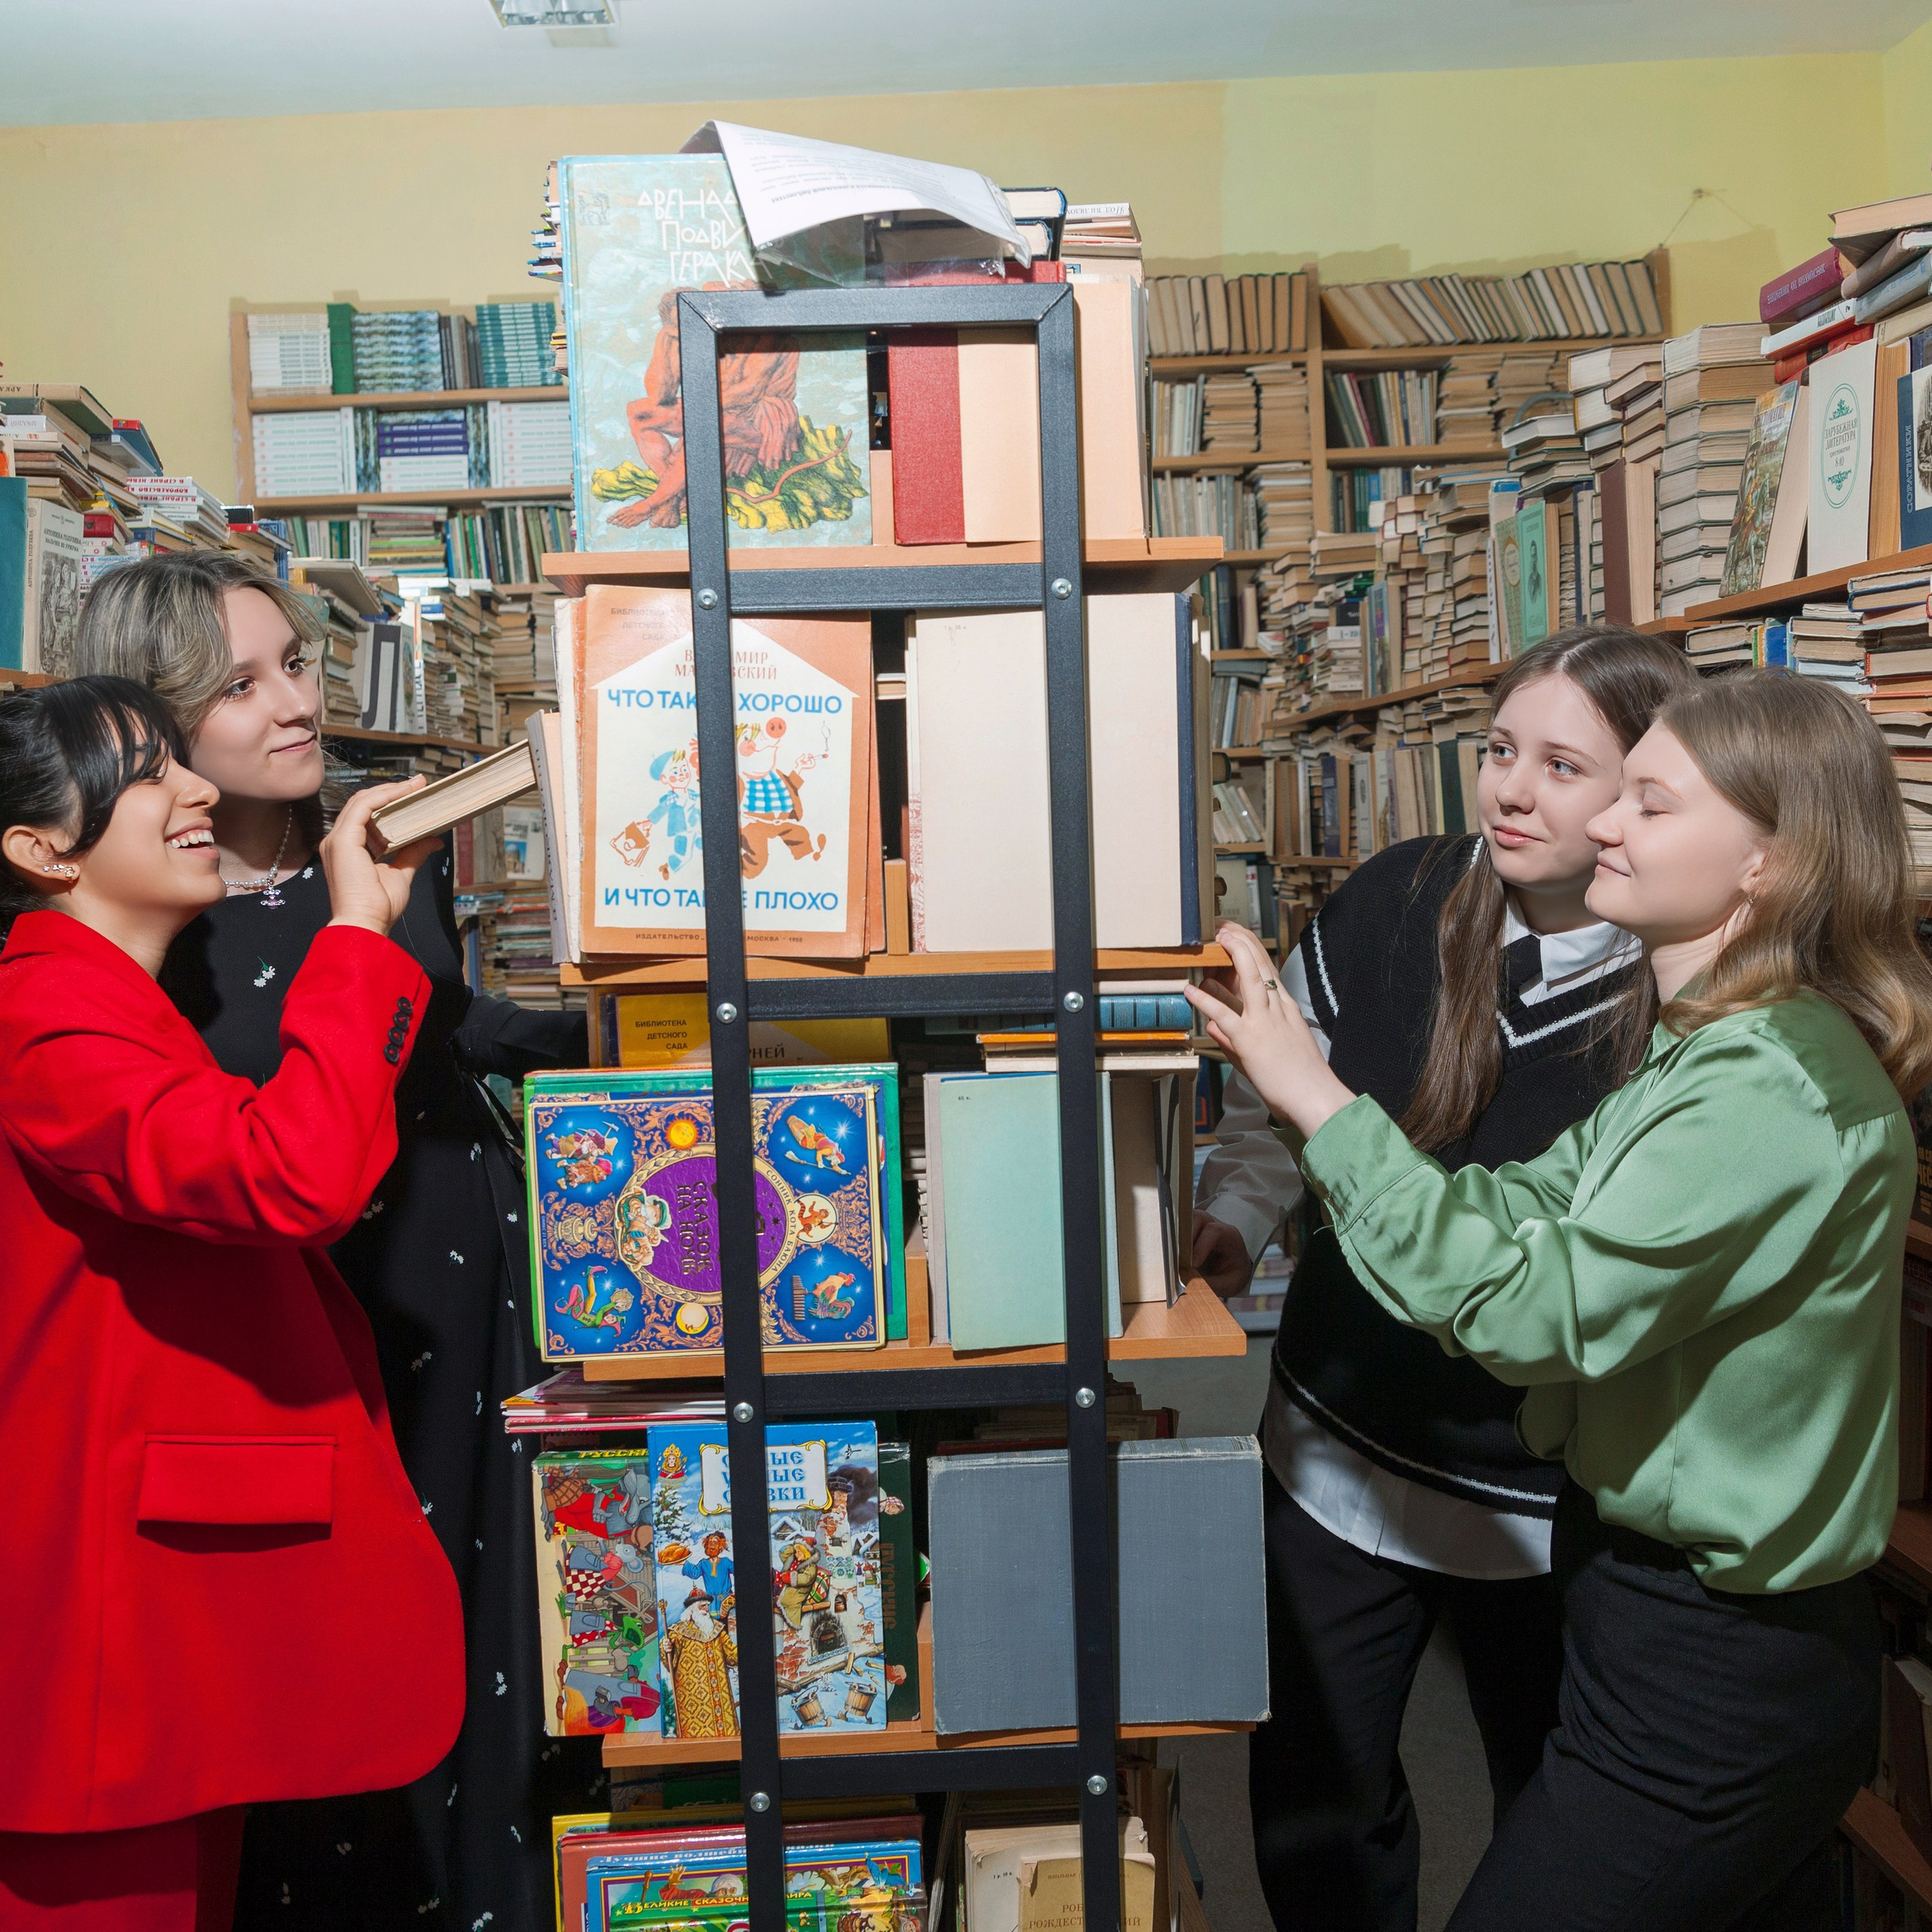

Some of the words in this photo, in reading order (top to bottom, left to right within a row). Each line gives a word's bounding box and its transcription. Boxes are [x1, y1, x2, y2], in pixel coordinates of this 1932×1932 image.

[1824, 417, 1857, 439] ЗАРУБЕЖНАЯ
[1825, 429, 1856, 451] ЛИТЕРАТУРА
[611, 608, 666, 617] БИБЛИОТЕКА
[621, 621, 665, 629] ДЕТСКОГО
[641, 632, 665, 641] САДА
[608, 688, 654, 709] ЧТО
[657, 691, 699, 709] ТАК
[738, 693, 842, 714] ХОРОШО
[605, 888, 619, 906] И
[626, 888, 671, 907] ЧТО
[755, 891, 838, 911] ПЛОХО
[635, 933, 700, 941] ИЗДАТЕЛЬСТВО
[635, 1020, 688, 1028] БИБЛИОТЕКА
[647, 1032, 688, 1040] ДЕТСКОГО
[766, 1170, 792, 1205] СОННИК
[677, 1185, 692, 1213] НА
[693, 1181, 712, 1272] СКАЗОК
[679, 1221, 697, 1275] НОЧЬ
[771, 1240, 793, 1272] БАЮНА
[674, 1847, 747, 1859] волшебн
[623, 1899, 689, 1915] ВЕЛИКИЕ
[694, 1896, 749, 1906] СКАЗОЧН
